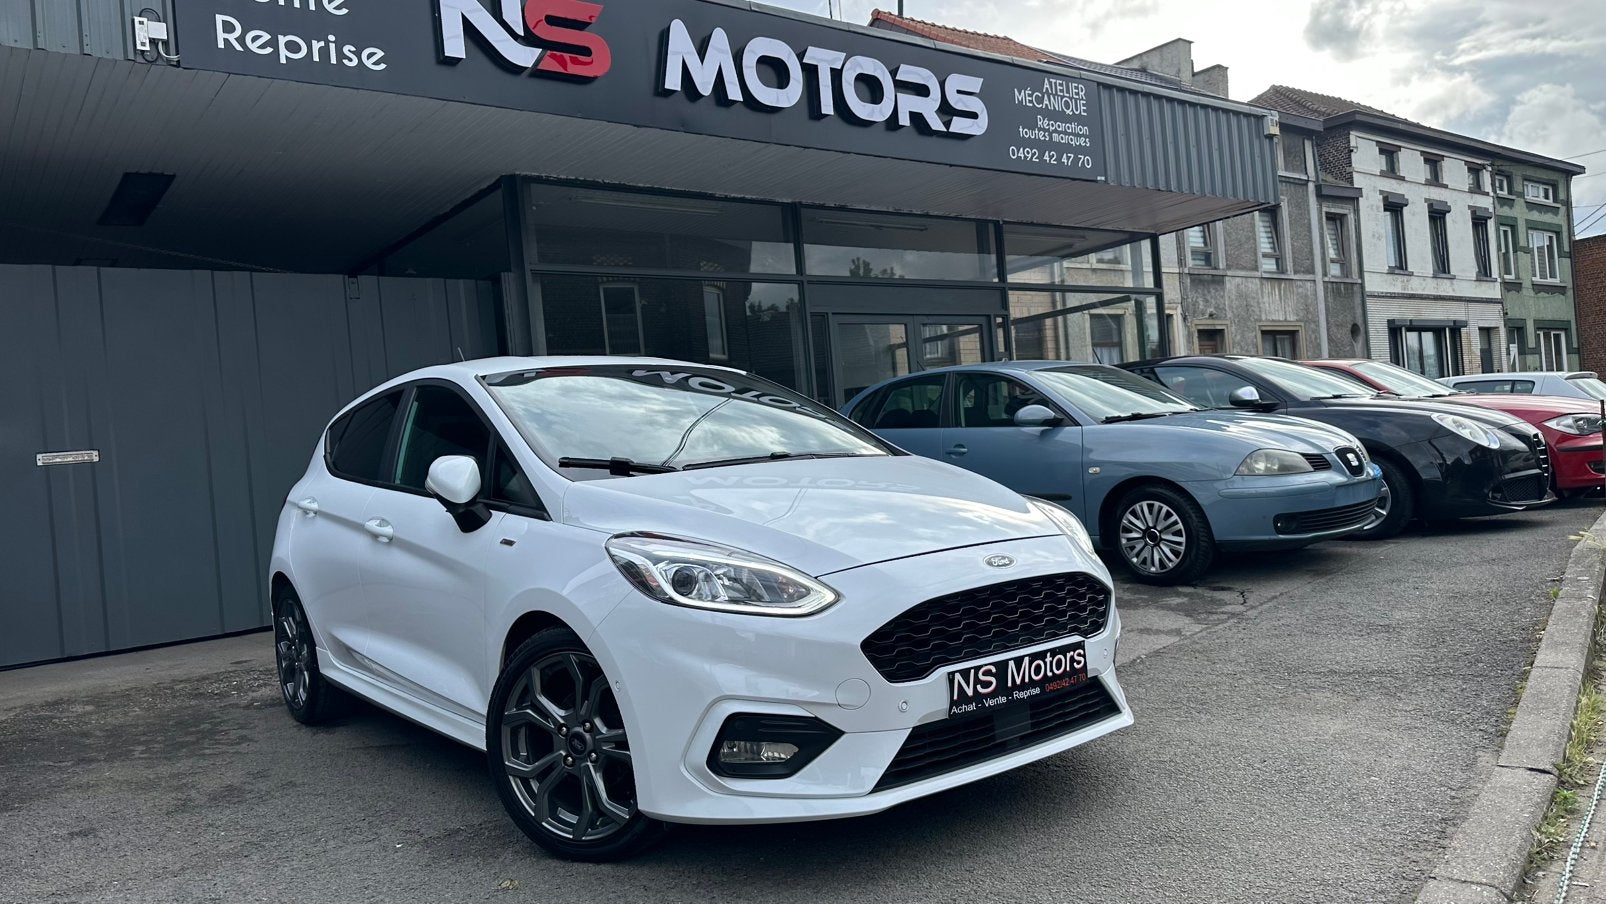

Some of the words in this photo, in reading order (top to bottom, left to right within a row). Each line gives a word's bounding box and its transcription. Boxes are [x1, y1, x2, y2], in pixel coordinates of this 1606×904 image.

[215, 13, 388, 71] Reprise
[440, 0, 612, 78] NS
[664, 18, 989, 136] MOTORS
[1014, 87, 1087, 116] MÉCANIQUE
[1043, 77, 1086, 100] ATELIER
[1019, 125, 1049, 141] toutes
[1052, 132, 1090, 147] marques
[1037, 115, 1089, 135] Réparation
[1009, 146, 1039, 162] 0492
[1043, 150, 1057, 164] 42
[1061, 153, 1074, 166] 47
[1078, 155, 1092, 169] 70
[953, 665, 997, 701] NS
[1007, 648, 1085, 688] Motors
[950, 702, 977, 715] Achat
[983, 695, 1007, 707] Vente
[1013, 687, 1041, 700] Reprise
